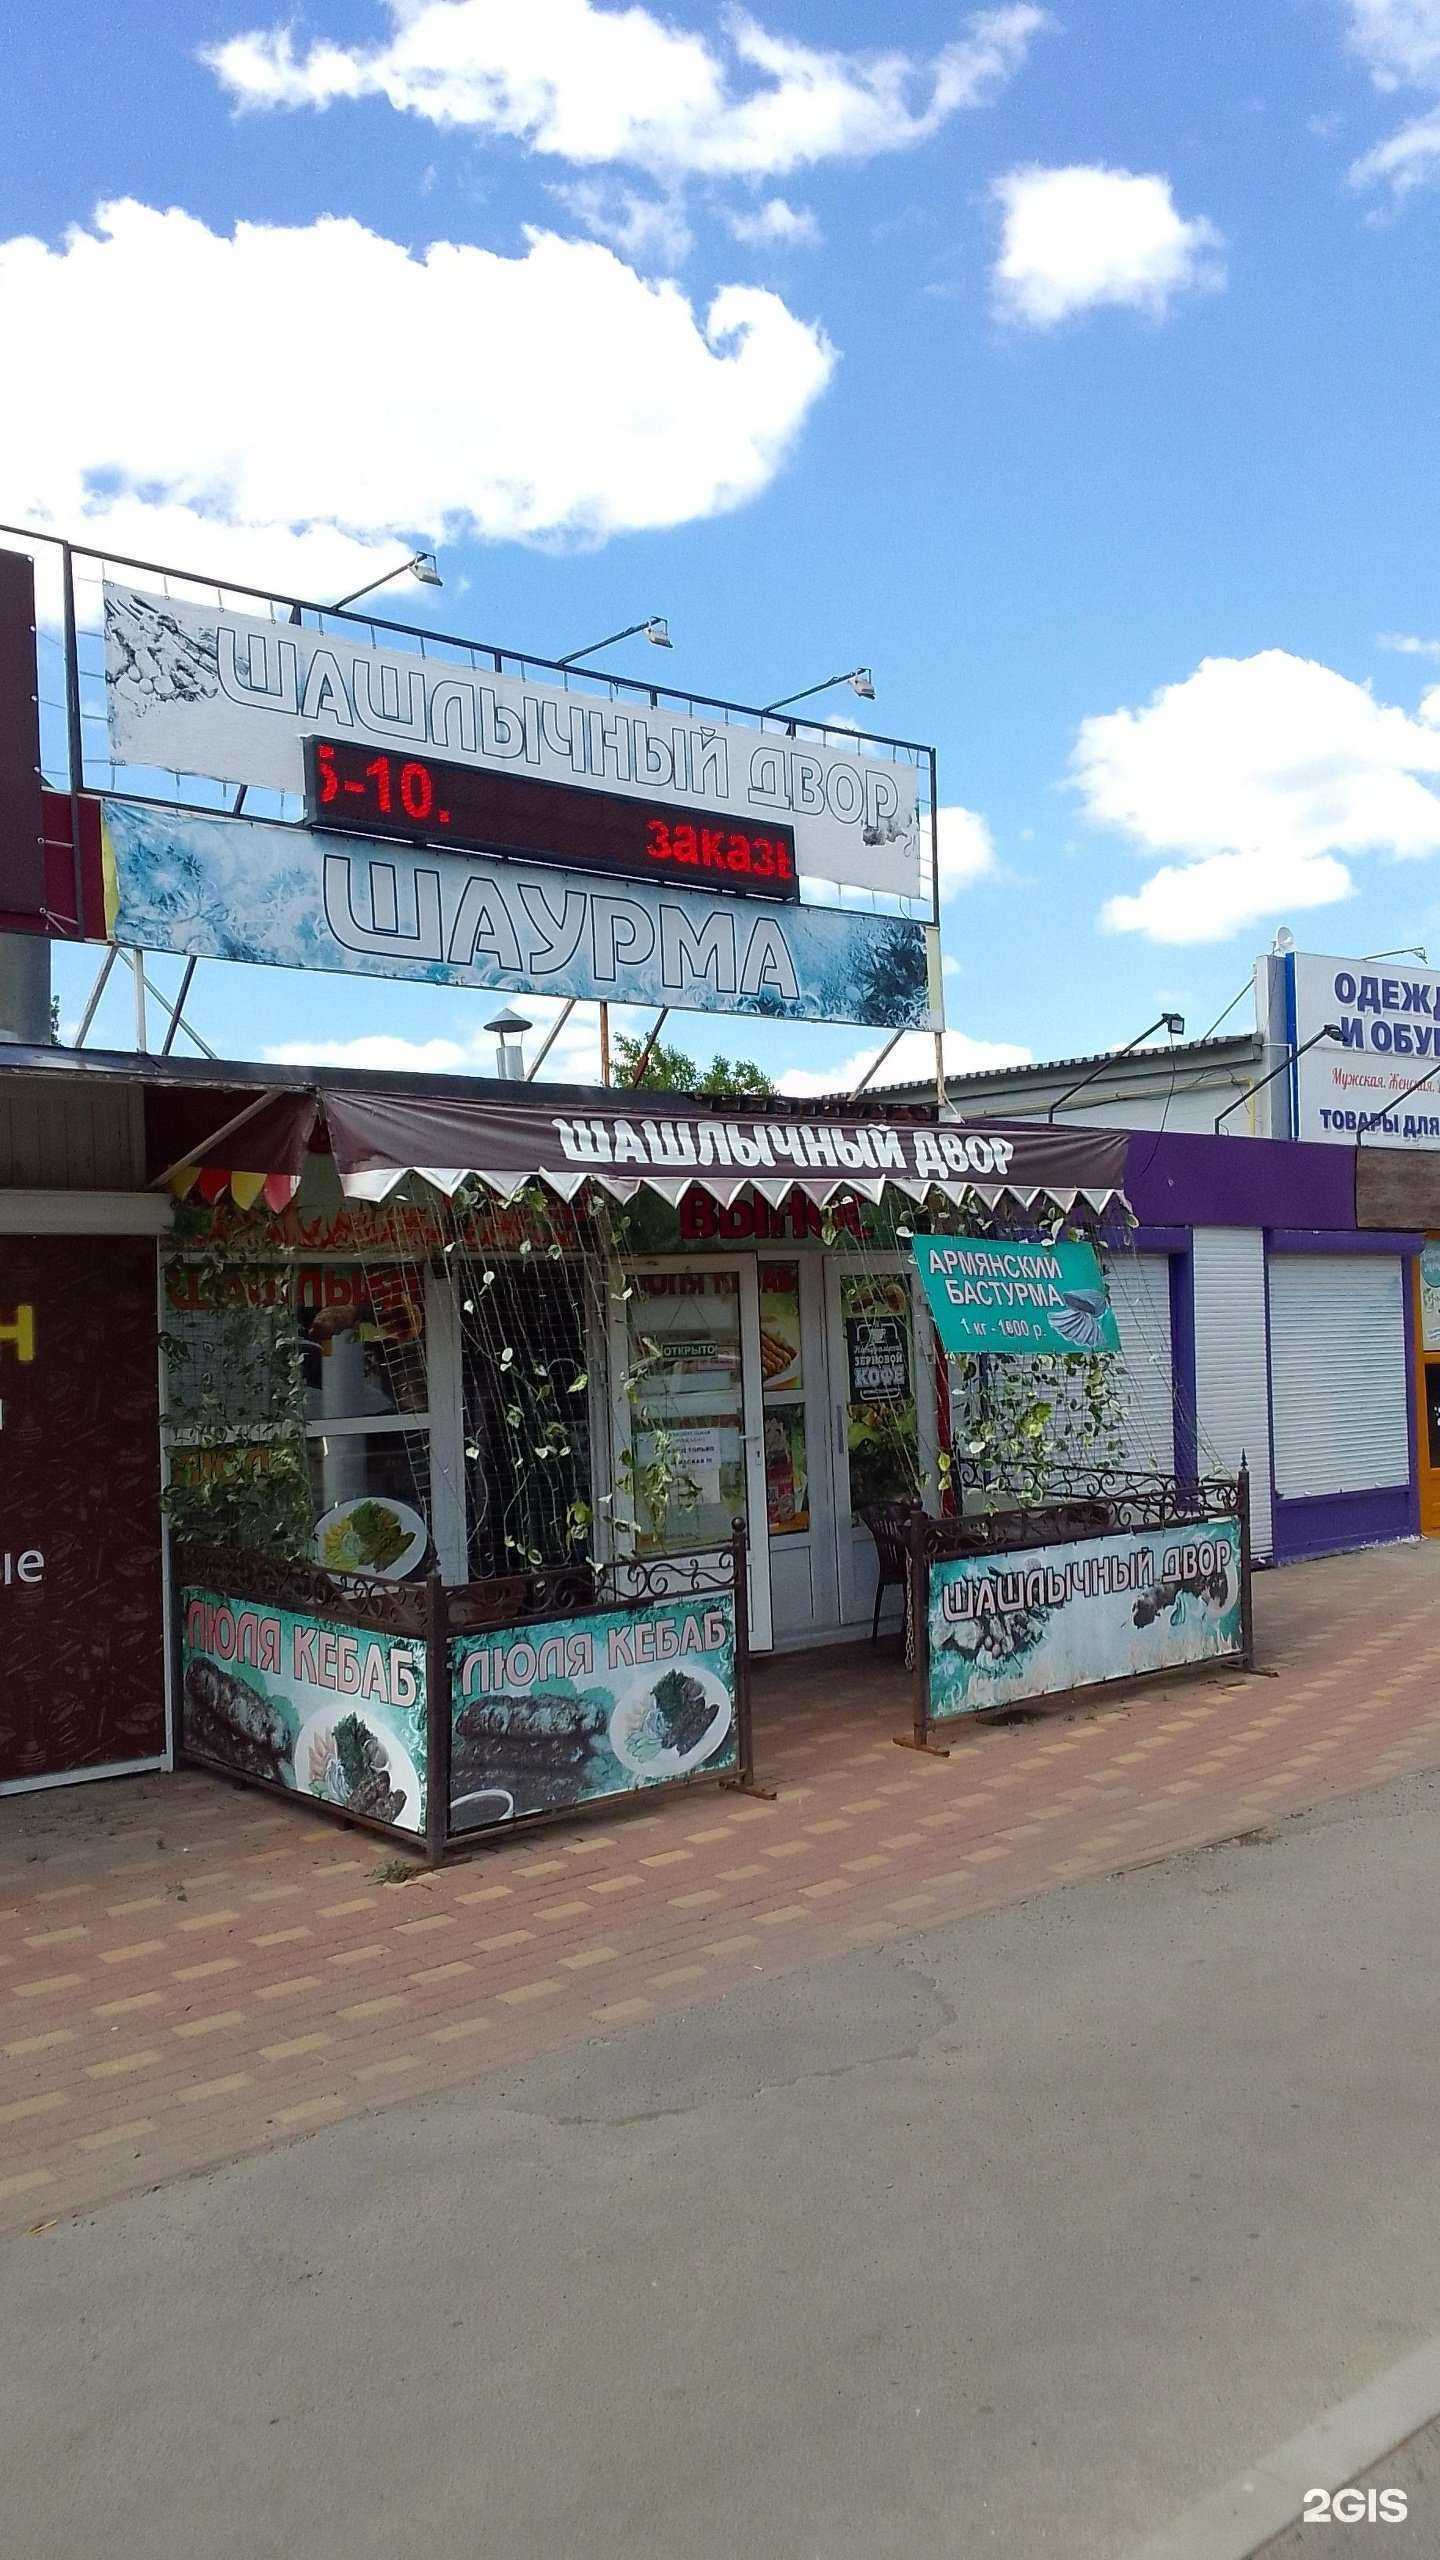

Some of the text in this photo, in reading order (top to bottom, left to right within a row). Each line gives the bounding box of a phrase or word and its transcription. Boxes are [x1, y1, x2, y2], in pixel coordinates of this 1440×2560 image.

[217, 627, 899, 828] ШАШЛЫЧНЫЙ ДВОР
[324, 854, 799, 1000] ШАУРМА
[1340, 1016, 1364, 1049] И
[1389, 1073, 1435, 1092] Женсая.
[1320, 1108, 1440, 1138] ТОВАРЫ ДЛЯ
[552, 1117, 1014, 1178] ШАШЛЫЧНЫЙ ДВОР
[945, 1280, 1065, 1307] БАСТУРМА
[961, 1318, 971, 1335] 1
[663, 1344, 716, 1357] ОТКРЫТО
[942, 1539, 1232, 1622] ШАШЛЫЧНЫЙ ДВОР
[187, 1600, 417, 1707] ЛЮЛЯ КЕБАБ
[461, 1610, 727, 1697] ЛЮЛЯ КЕБАБ
